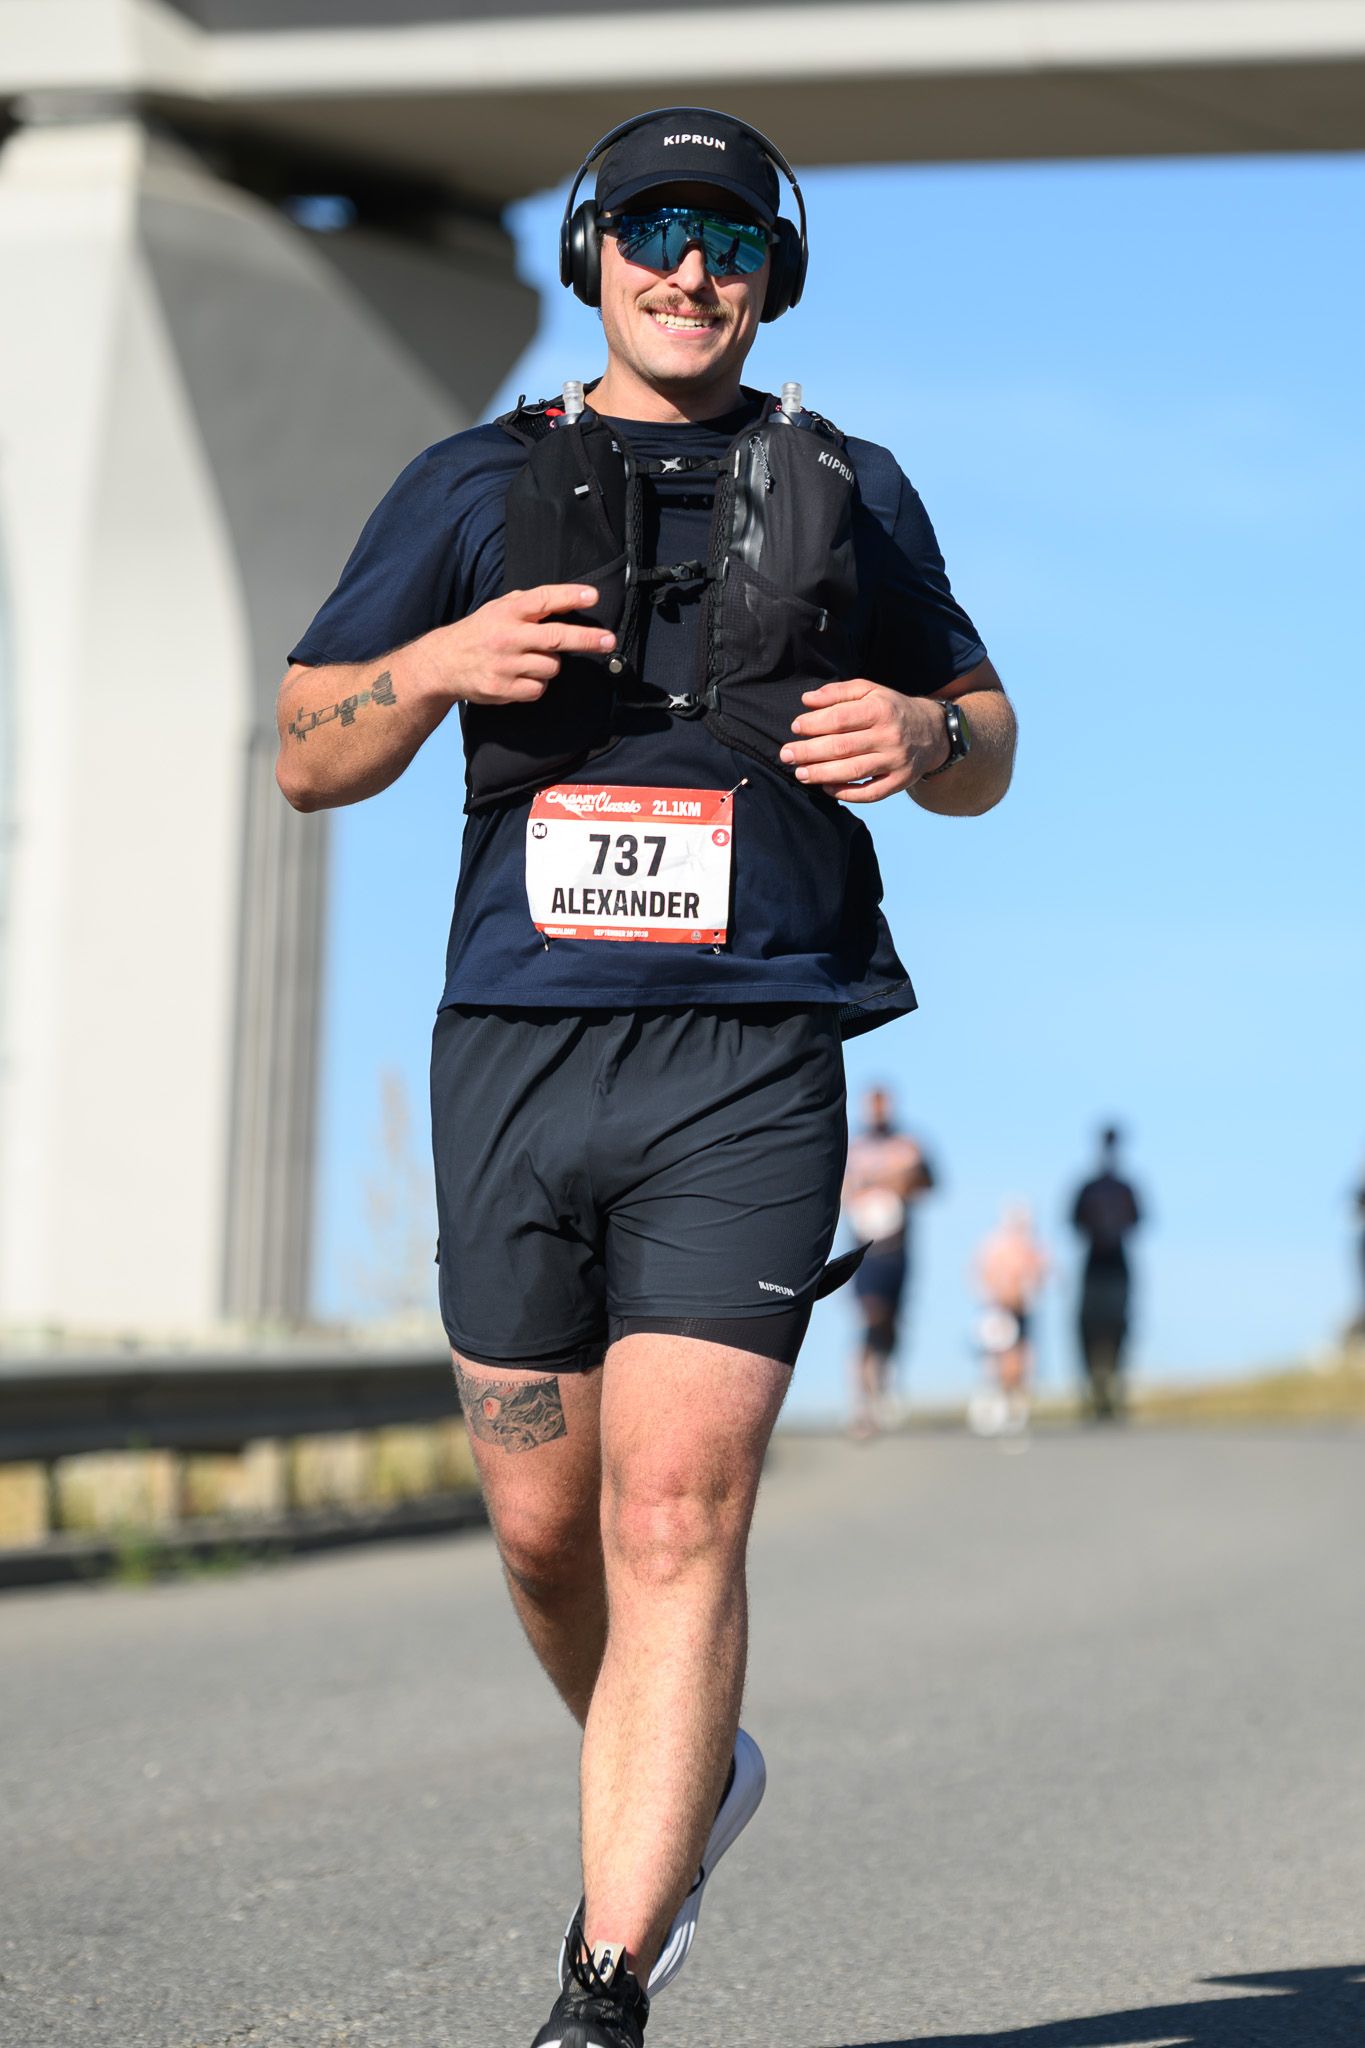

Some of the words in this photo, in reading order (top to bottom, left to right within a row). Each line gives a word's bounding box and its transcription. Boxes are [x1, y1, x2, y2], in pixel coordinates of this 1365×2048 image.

[663, 133, 726, 151] KIPRUN
[545, 791, 597, 805] CALGARY
[595, 791, 642, 813] Classic
[652, 799, 701, 817] 21.1KM
[533, 824, 546, 837] M
[589, 834, 667, 877] 737
[551, 887, 700, 919] ALEXANDER
[758, 1280, 795, 1297] KIPRUN
